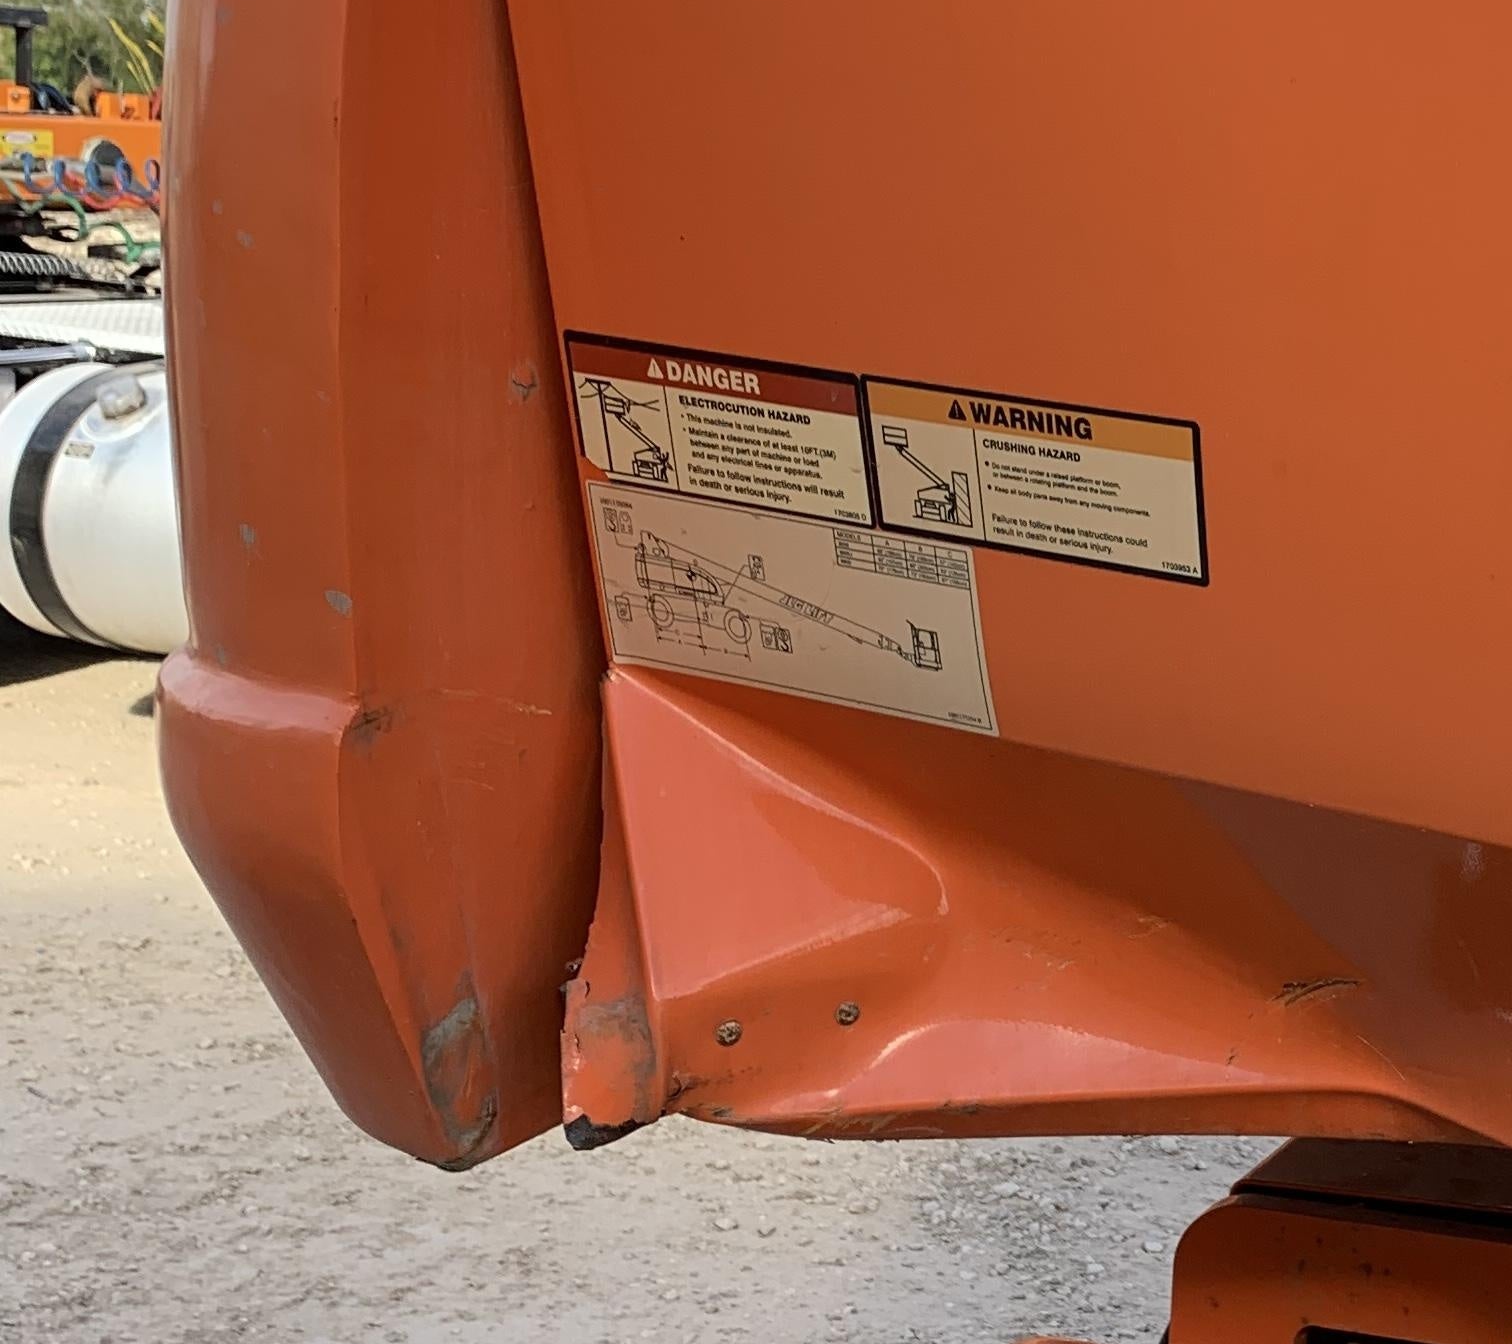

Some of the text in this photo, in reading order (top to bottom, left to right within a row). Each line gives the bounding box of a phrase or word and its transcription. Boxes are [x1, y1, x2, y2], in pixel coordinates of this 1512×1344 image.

[666, 359, 761, 396] DANGER
[678, 395, 811, 425] ELECTROCUTION HAZARD
[686, 413, 702, 424] This
[703, 417, 734, 429] machine
[734, 421, 742, 430] is
[743, 424, 755, 433] not
[969, 401, 1093, 441] WARNING
[688, 426, 719, 439] Maintain
[726, 434, 761, 446] clearance
[763, 440, 770, 449] of
[772, 441, 779, 449] at
[780, 443, 798, 453] least
[982, 438, 1081, 463] CRUSHING HAZARD
[689, 439, 820, 468] between any part of machine or load
[691, 450, 705, 459] and
[706, 453, 720, 463] any
[721, 455, 754, 467] electrical
[754, 460, 773, 471] lines
[783, 466, 823, 479] apparatus.
[687, 463, 845, 499] Failure to follow instructions will result
[991, 462, 1000, 470] Do
[1011, 466, 1027, 475] stand
[1028, 469, 1045, 477] under
[1069, 475, 1093, 485] platform
[1000, 472, 1023, 482] between
[1029, 477, 1051, 488] rotating
[1052, 481, 1076, 490] platform
[1089, 486, 1099, 494] the
[688, 476, 792, 504] in death or serious injury.
[994, 486, 1009, 494] Keep
[1018, 489, 1032, 499] body
[1033, 492, 1048, 501] parts
[1048, 496, 1064, 504] away
[1064, 497, 1078, 505] from
[1079, 500, 1089, 509] any
[1090, 502, 1112, 512] moving
[991, 513, 1149, 548] Failure to follow these instructions could
[992, 526, 1015, 537] result
[1015, 528, 1024, 538] in
[1025, 531, 1048, 543] death
[1049, 536, 1058, 544] or
[1059, 537, 1089, 550] serious
[1192, 566, 1199, 575] A
